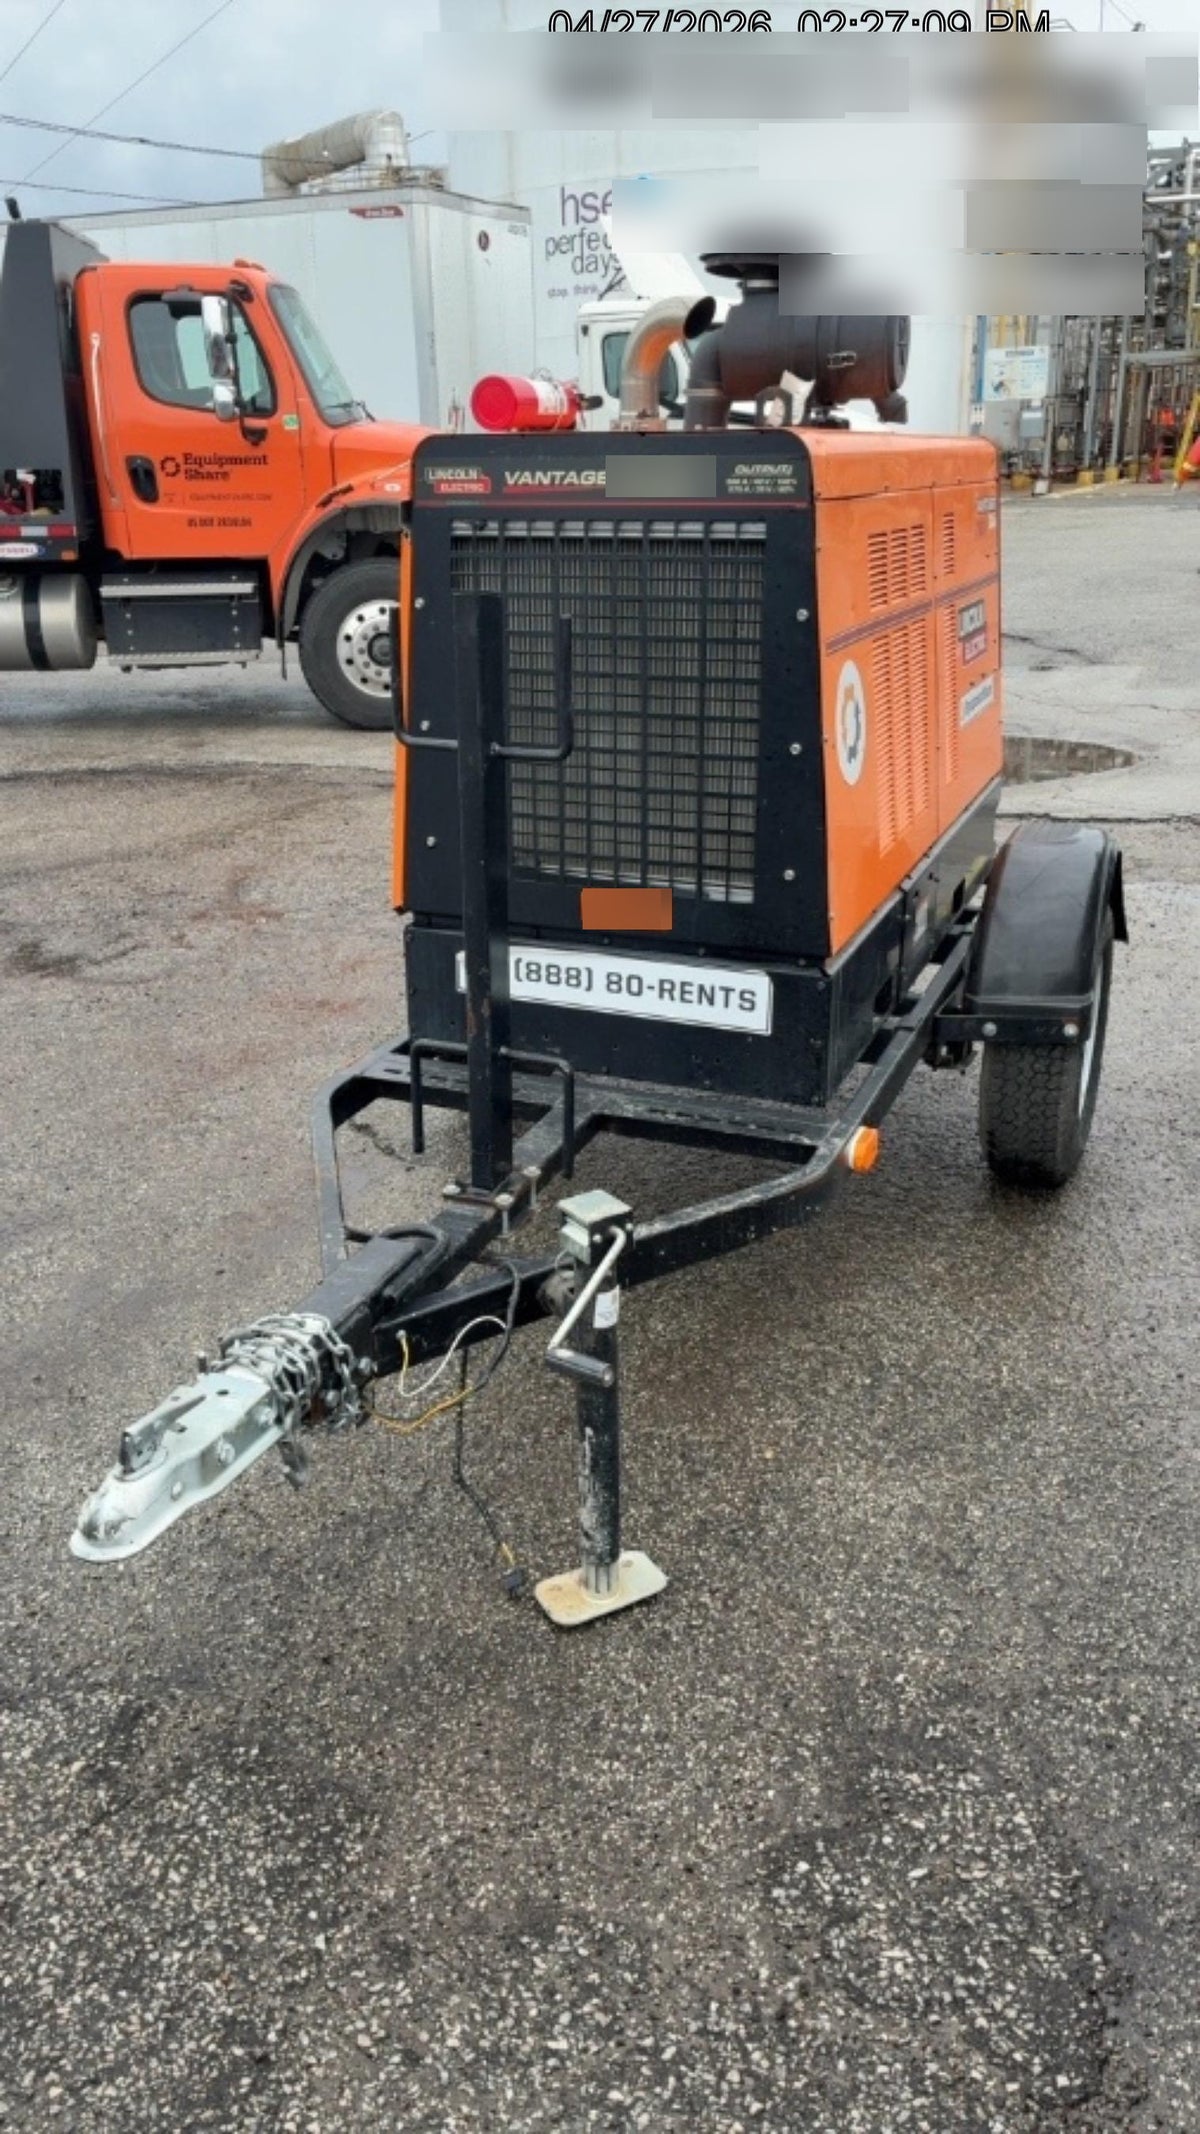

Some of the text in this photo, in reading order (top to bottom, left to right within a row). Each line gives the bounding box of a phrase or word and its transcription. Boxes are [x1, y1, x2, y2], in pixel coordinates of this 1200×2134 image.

[182, 452, 268, 468] Equipment
[184, 468, 229, 481] Share
[428, 468, 478, 480] LINCOLN
[504, 471, 606, 485] VANTAGE
[514, 957, 757, 1012] (888) 80-RENTS
